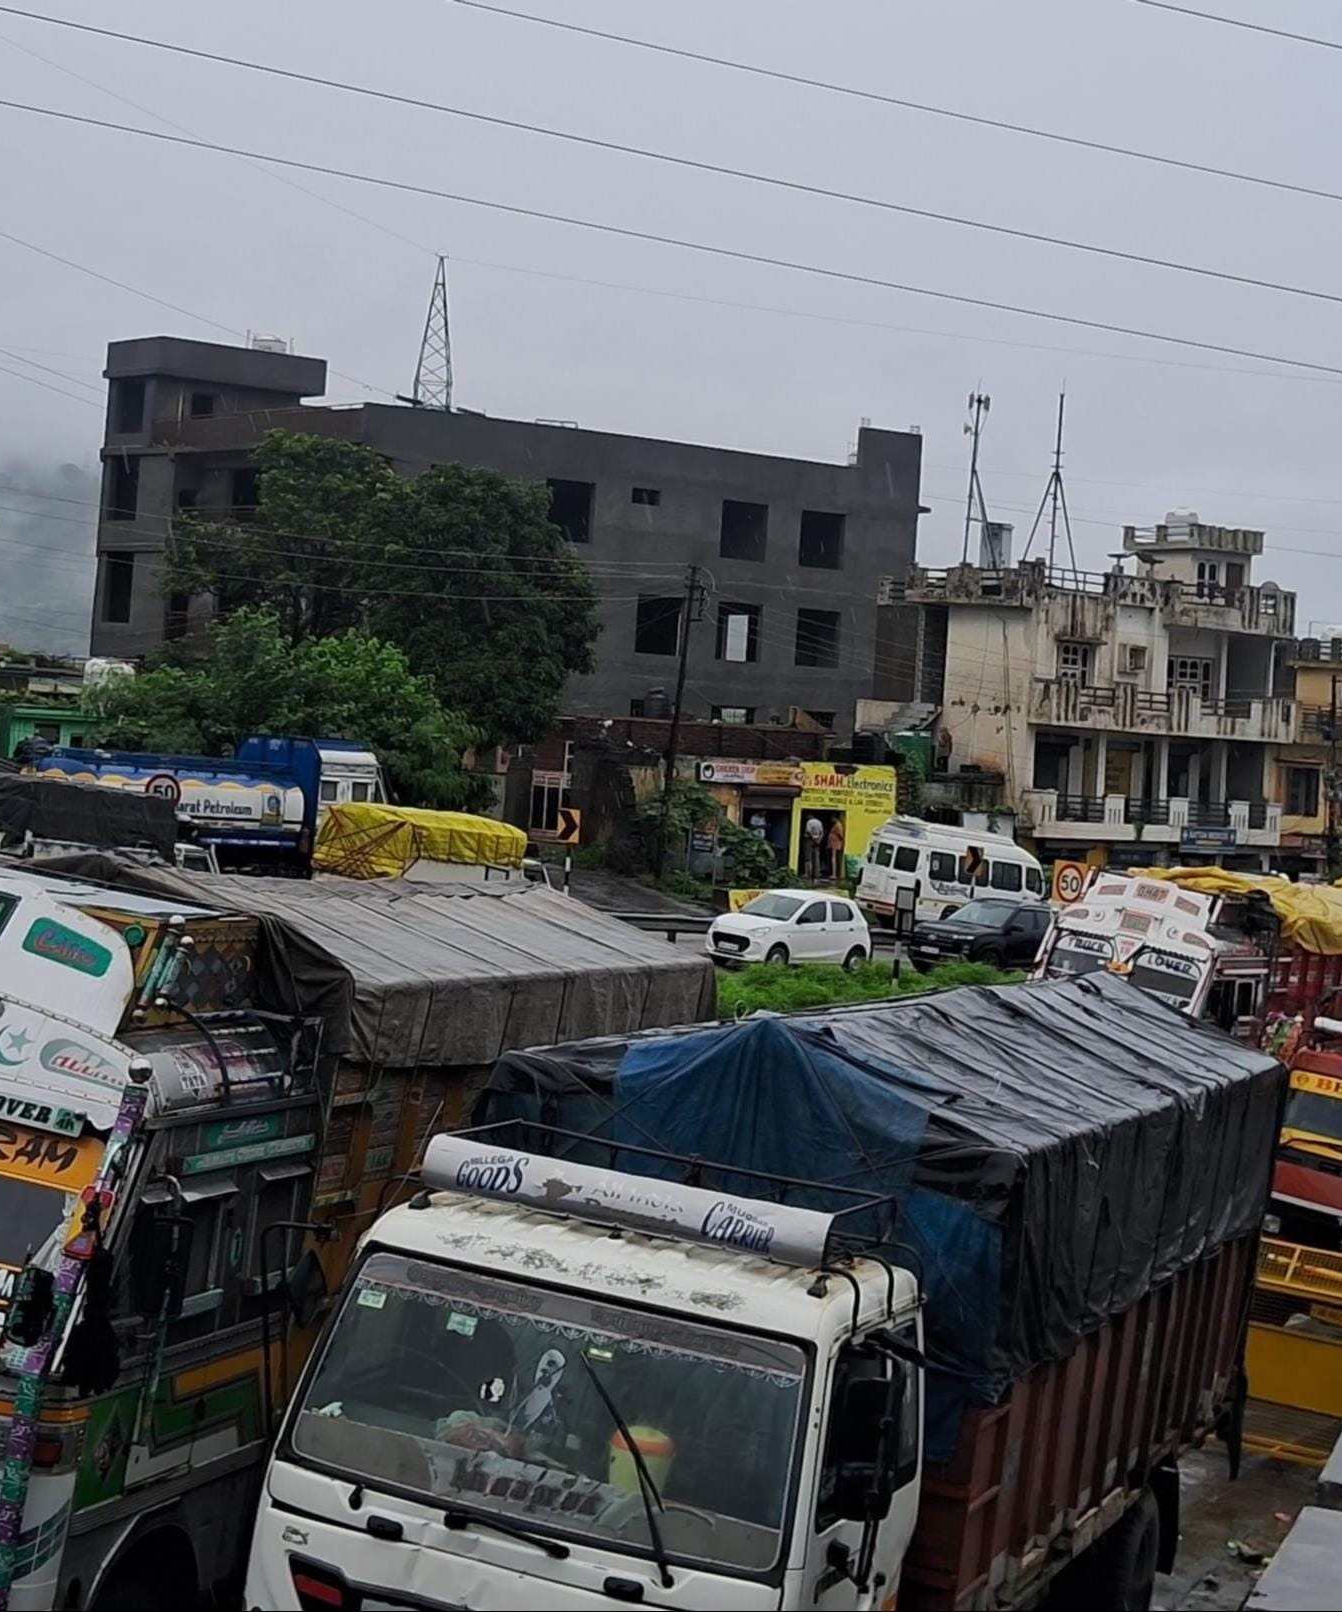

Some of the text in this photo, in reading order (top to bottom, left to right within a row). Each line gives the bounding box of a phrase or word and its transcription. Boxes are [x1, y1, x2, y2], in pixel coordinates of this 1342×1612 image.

[153, 784, 175, 800] 50
[814, 773, 844, 789] SHAH
[846, 774, 894, 793] Electronics
[175, 799, 253, 817] arat Petroleum
[1060, 875, 1080, 893] 50
[1067, 937, 1106, 955] TRUCK
[1147, 954, 1193, 974] LOVER
[181, 1073, 208, 1091] TATA
[455, 1156, 531, 1195] GOODS
[700, 1201, 775, 1255] CARRIER
